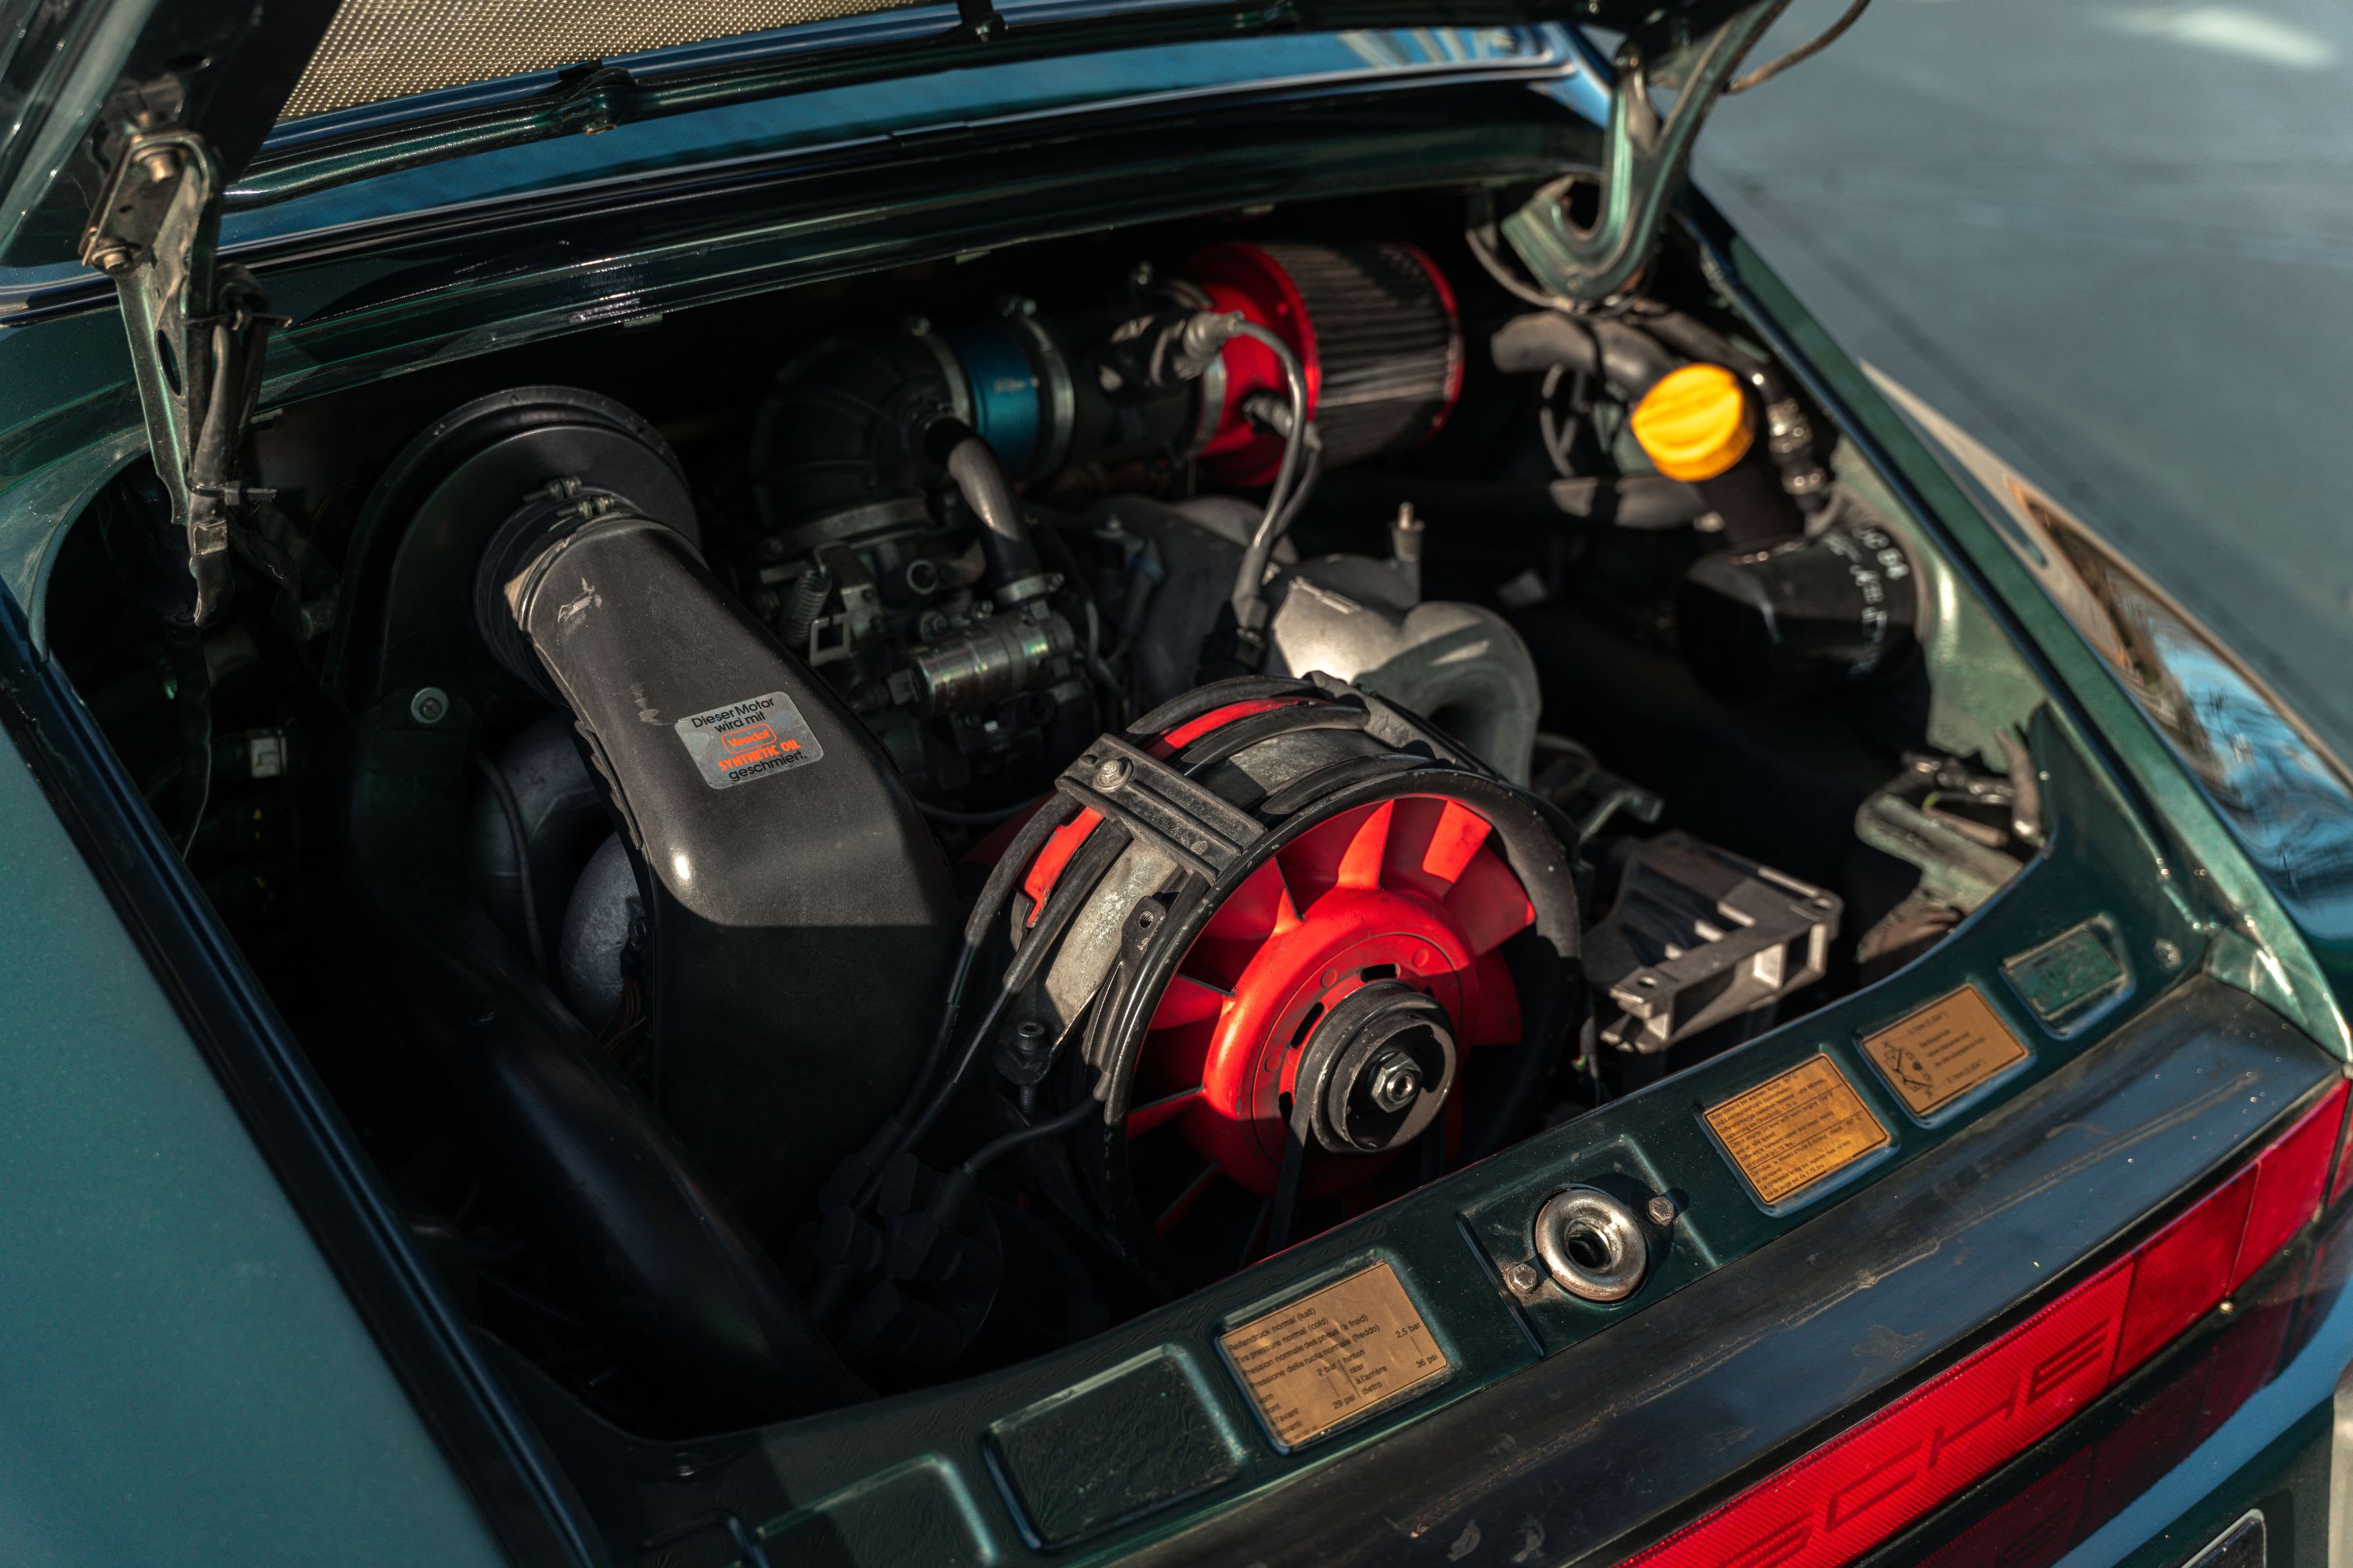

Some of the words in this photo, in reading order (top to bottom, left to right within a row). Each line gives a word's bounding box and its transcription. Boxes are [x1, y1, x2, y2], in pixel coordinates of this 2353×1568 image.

[692, 709, 734, 728] Dieser
[734, 698, 774, 715] Motor
[715, 718, 744, 733] wird
[745, 711, 766, 725] mit
[727, 729, 771, 748] Veedol
[718, 744, 780, 771] SYNTHETIC
[780, 738, 802, 752] OIL
[729, 750, 806, 781] geschmiert.
[1271, 1317, 1296, 1331] normal
[1297, 1308, 1315, 1319] (kalt)
[1243, 1359, 1274, 1377] Pression
[1275, 1345, 1303, 1362] normale
[1304, 1338, 1317, 1348] des
[1318, 1328, 1339, 1341] pneus
[1350, 1315, 1368, 1326] froid)
[1249, 1340, 1281, 1357] pressure
[1282, 1327, 1307, 1342] normal
[1308, 1317, 1328, 1330] (cold)
[1343, 1349, 1365, 1362] hinten
[1408, 1322, 1420, 1331] bar
[1251, 1370, 1285, 1389] Pressione
[1287, 1360, 1304, 1372] della
[1304, 1352, 1322, 1363] ruota
[1322, 1338, 1351, 1355] normale
[1352, 1324, 1380, 1341] (freddo)
[1323, 1362, 1337, 1372] bar
[1349, 1362, 1364, 1373] rear
[1362, 1381, 1381, 1394] dietro
[1426, 1353, 1438, 1362] psi
[1344, 1394, 1356, 1403] psi
